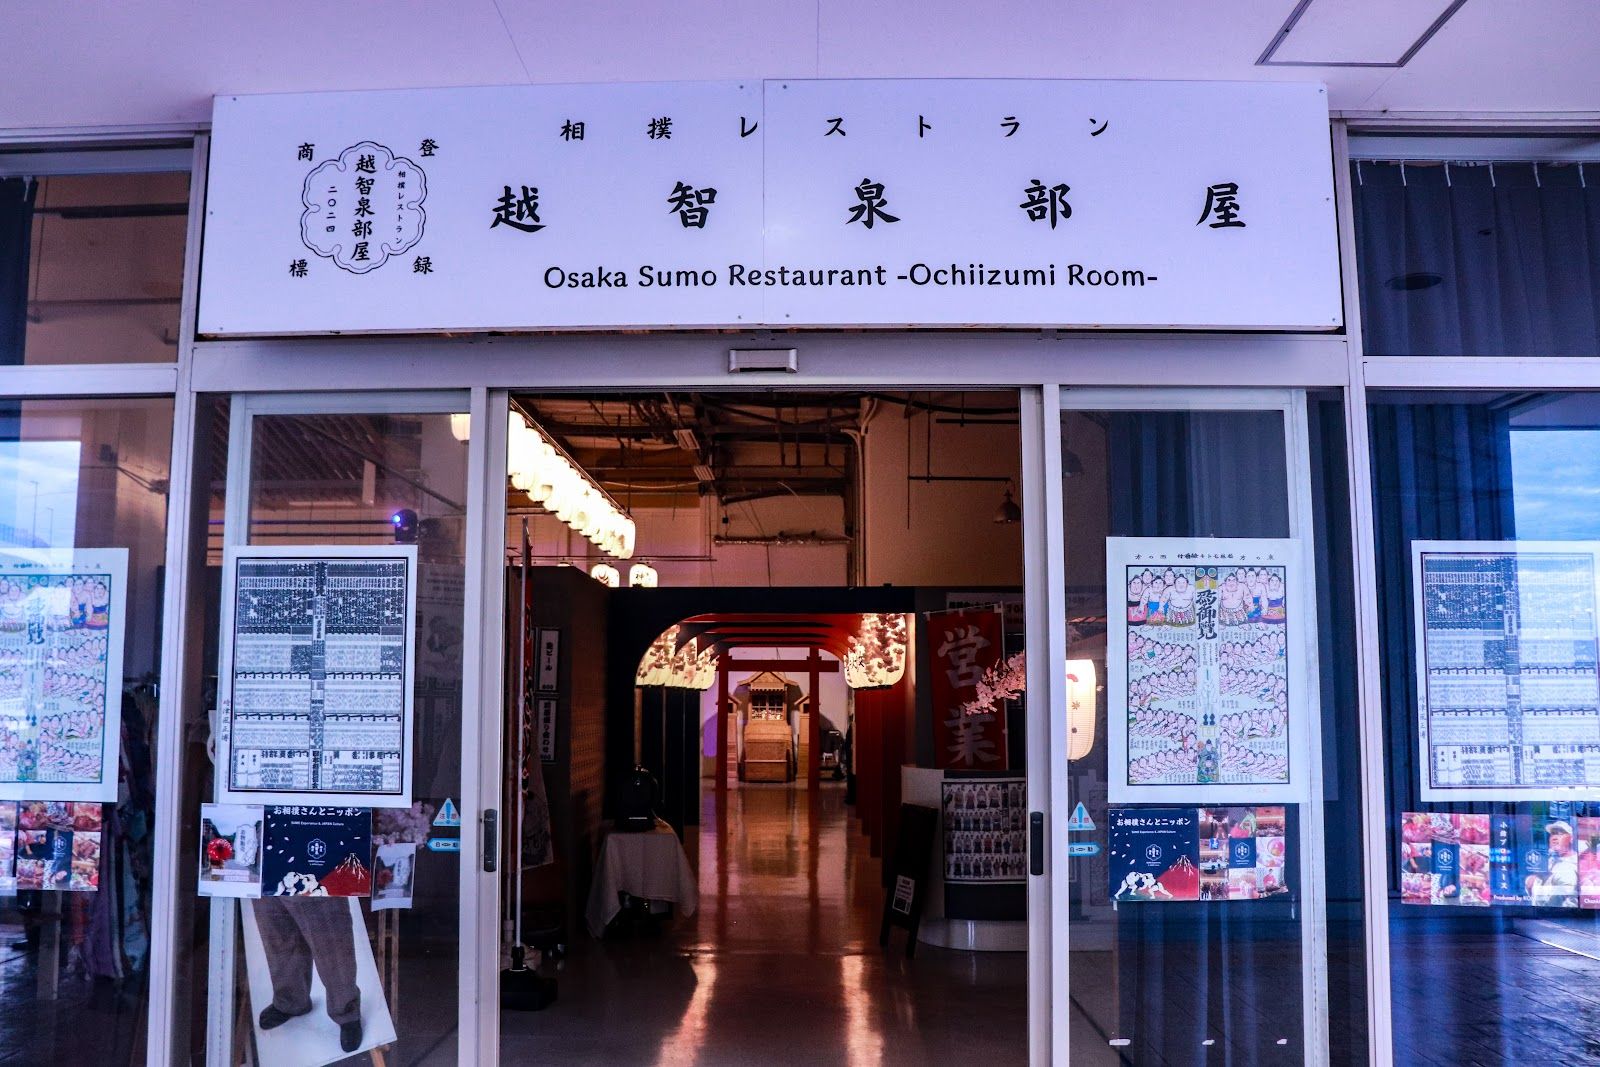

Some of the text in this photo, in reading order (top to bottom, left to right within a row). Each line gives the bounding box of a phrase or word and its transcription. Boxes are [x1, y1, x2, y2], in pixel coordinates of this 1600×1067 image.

[560, 115, 1108, 141] 相撲レストラン
[297, 142, 315, 162] 商
[418, 138, 440, 158] 登
[325, 185, 338, 233] 二〇二四
[351, 154, 377, 262] 越智泉部屋
[395, 170, 406, 245] 相撲レストラン
[490, 178, 1246, 232] 越智泉部屋
[288, 258, 309, 278] 標
[412, 255, 434, 275] 録
[544, 264, 1157, 288] Osaka Sumo Restaurant -Ochiizumi Room-
[273, 805, 362, 817] お相撲さんとニッポン
[1116, 817, 1191, 827] お相撲さんとニッポン
